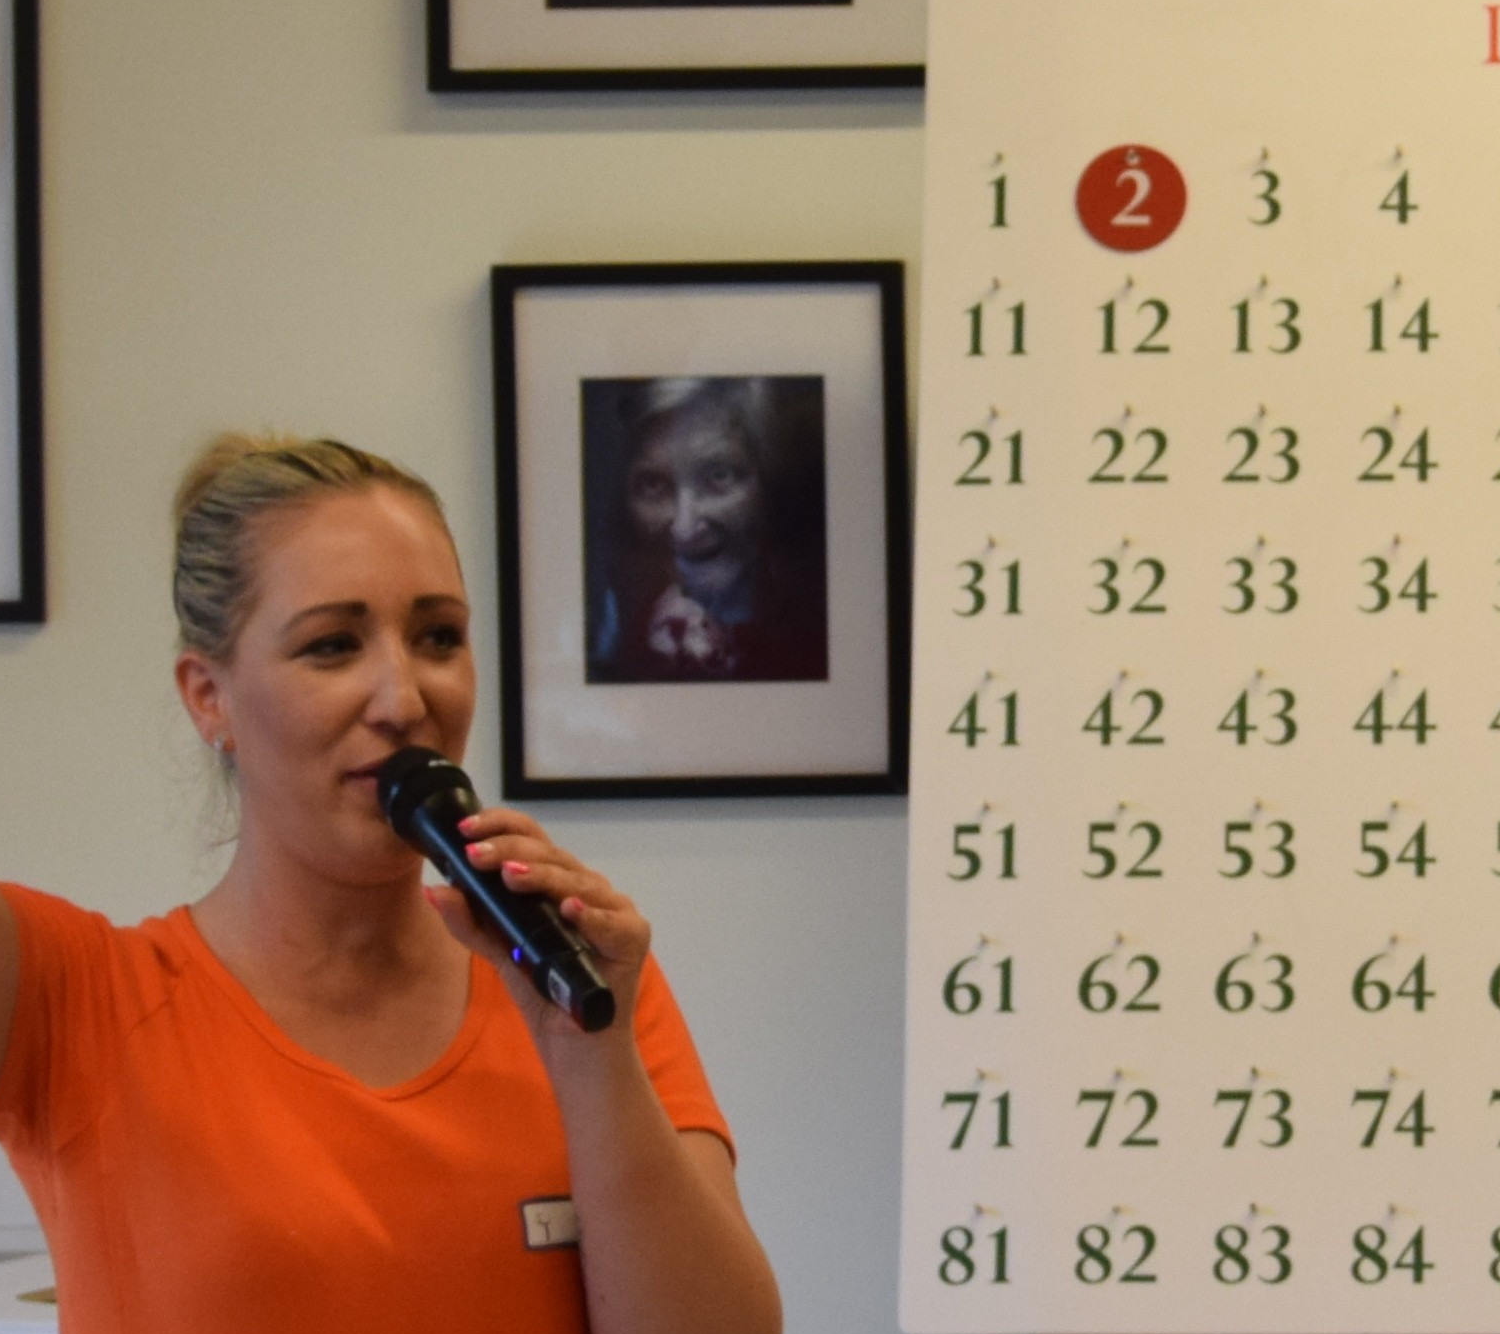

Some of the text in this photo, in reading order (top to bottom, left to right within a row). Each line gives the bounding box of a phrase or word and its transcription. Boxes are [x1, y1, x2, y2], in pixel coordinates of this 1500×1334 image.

[989, 175, 1008, 228] 1
[1111, 170, 1153, 225] 2
[1251, 168, 1282, 226] 3
[1378, 171, 1419, 225] 4
[965, 302, 1027, 357] 11
[1099, 298, 1171, 354] 12
[1232, 298, 1302, 354] 13
[1366, 298, 1440, 353] 14
[954, 429, 1024, 486] 21
[1087, 427, 1169, 484] 22
[1222, 426, 1301, 483] 23
[1357, 426, 1439, 483] 24
[957, 560, 1022, 617] 31
[1090, 557, 1168, 615] 32
[1226, 557, 1300, 614] 33
[1361, 556, 1438, 614] 34
[947, 692, 1020, 748] 41
[1081, 689, 1166, 746] 42
[1216, 688, 1299, 746] 43
[1352, 689, 1438, 745] 44
[948, 823, 1017, 881] 51
[1083, 821, 1164, 879] 52
[1220, 820, 1297, 879] 53
[1356, 821, 1437, 878] 54
[941, 957, 1015, 1015] 61
[1077, 954, 1162, 1013] 62
[1213, 954, 1296, 1013] 63
[1350, 954, 1436, 1012] 64
[941, 1091, 1012, 1150] 71
[1076, 1089, 1160, 1148] 72
[1214, 1089, 1295, 1148] 73
[1351, 1089, 1435, 1148] 74
[937, 1226, 1009, 1285] 81
[1073, 1225, 1158, 1284] 82
[1212, 1225, 1293, 1285] 83
[1350, 1225, 1435, 1284] 84
